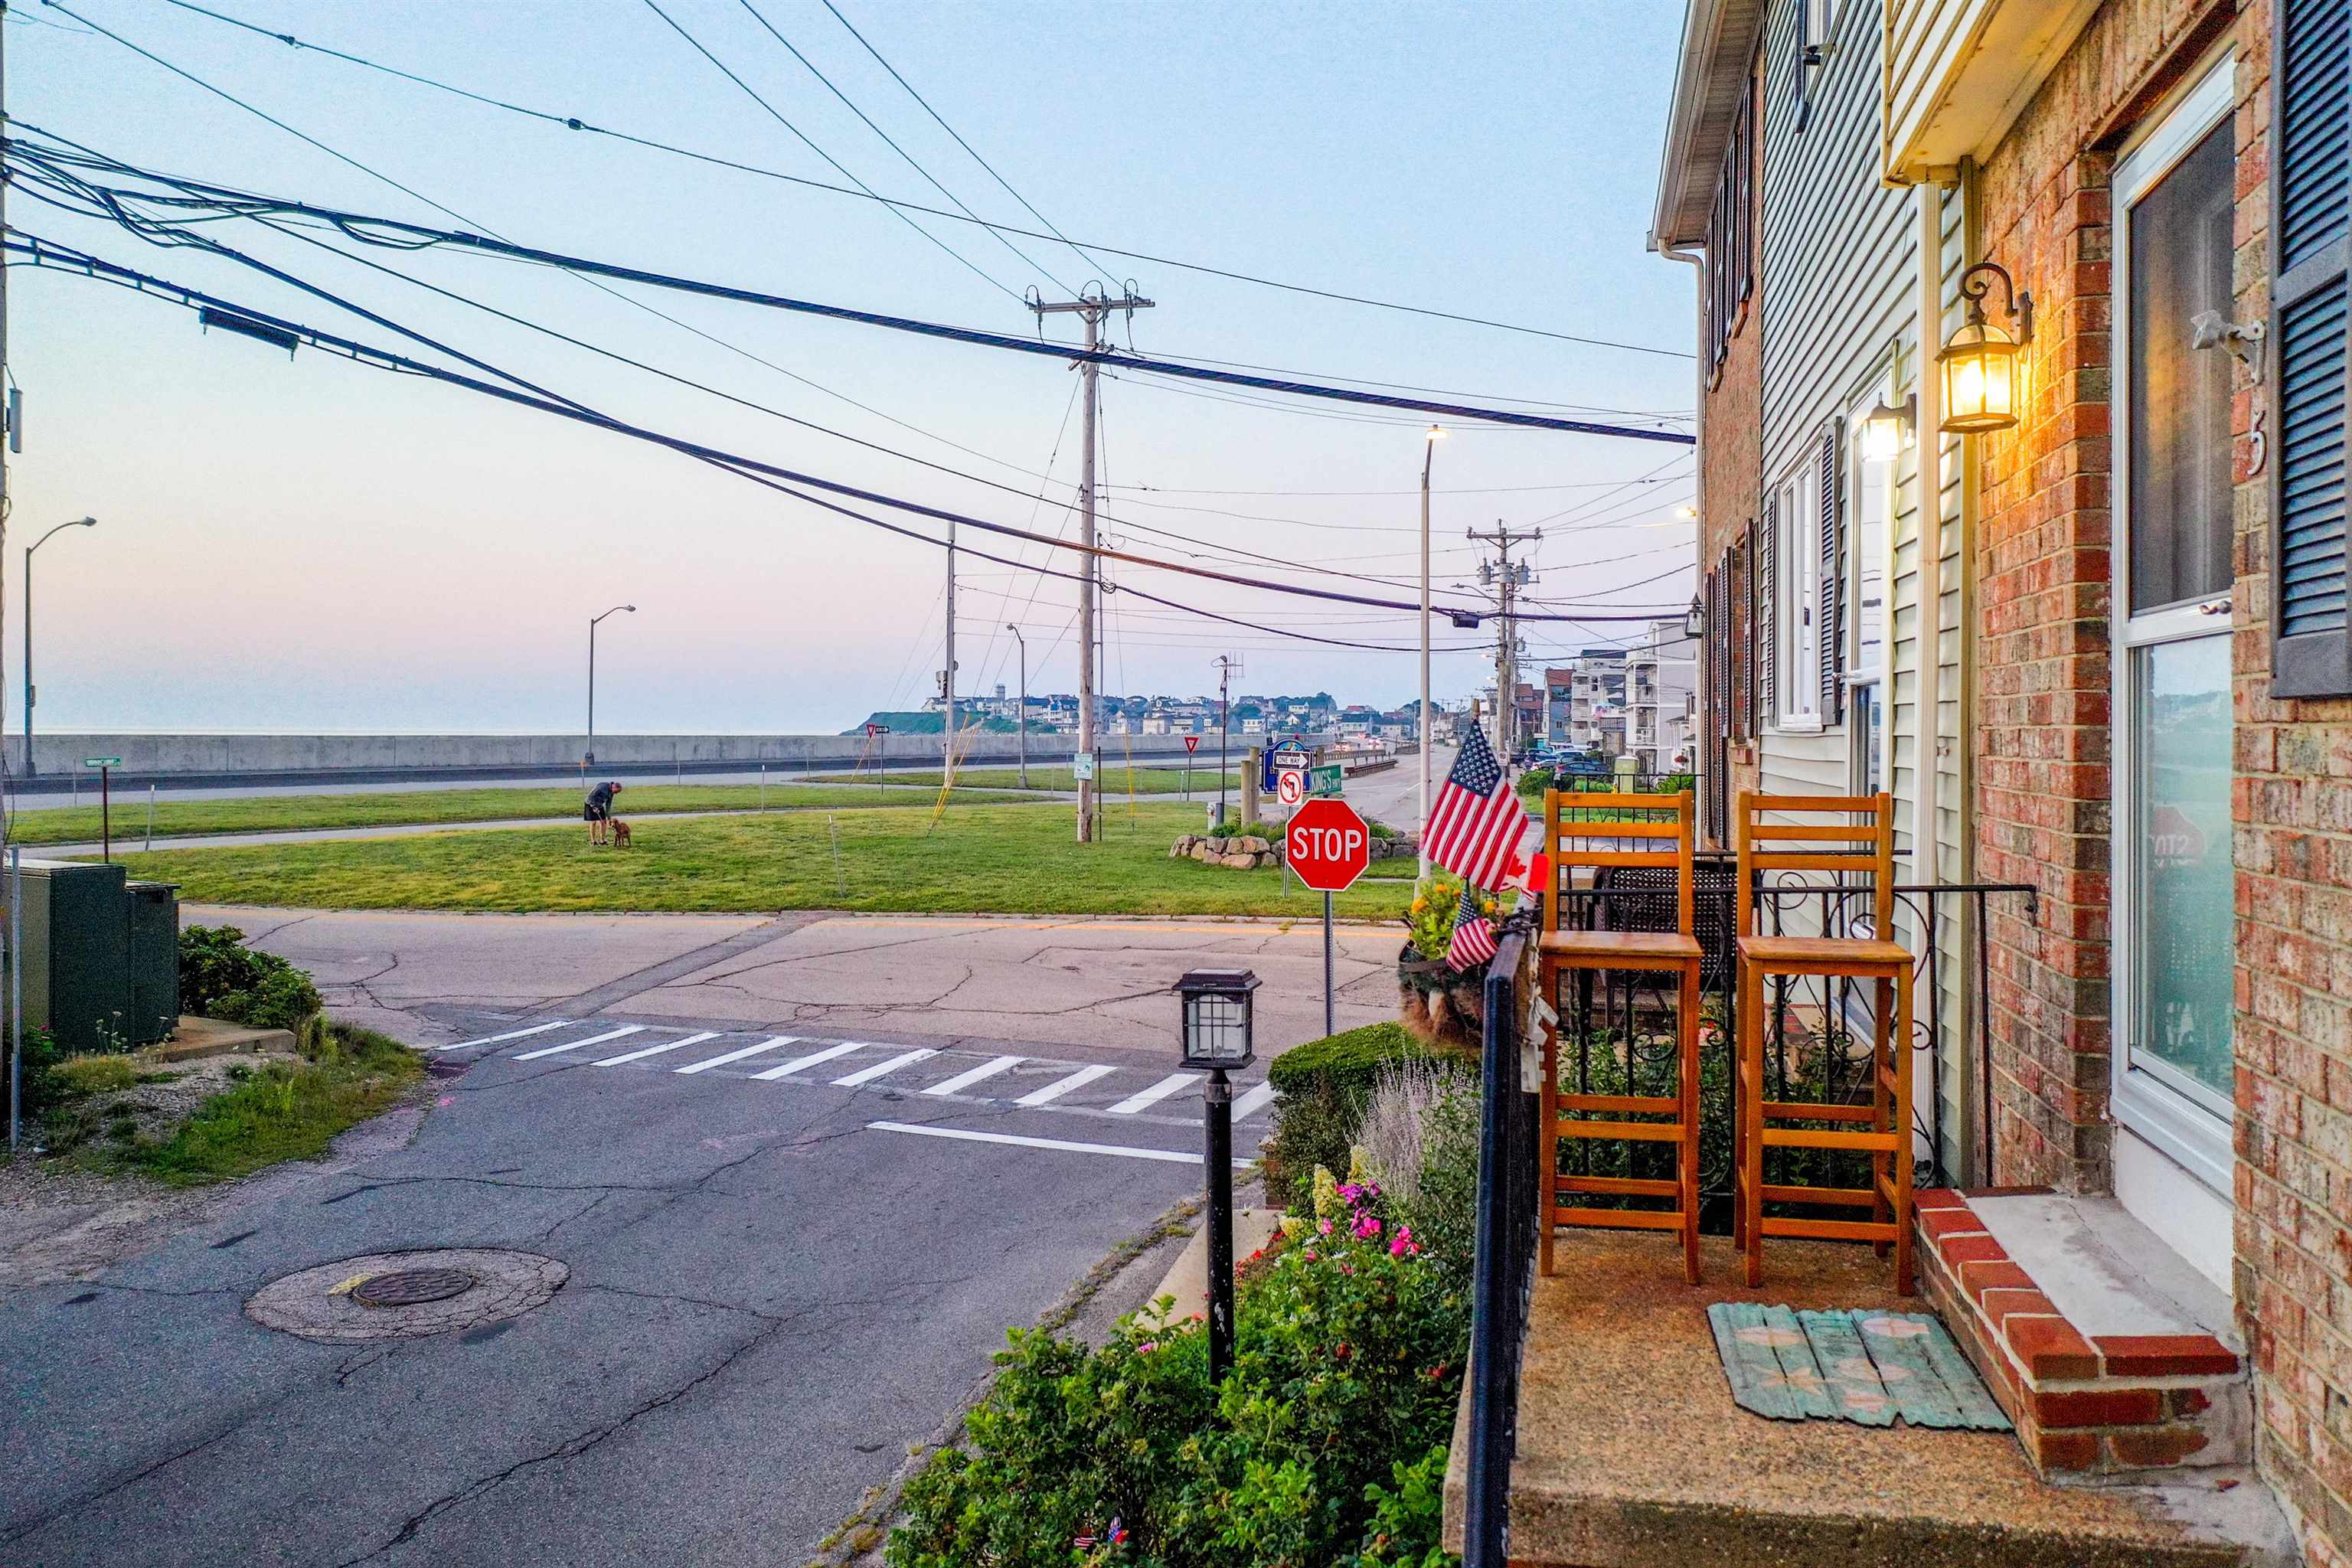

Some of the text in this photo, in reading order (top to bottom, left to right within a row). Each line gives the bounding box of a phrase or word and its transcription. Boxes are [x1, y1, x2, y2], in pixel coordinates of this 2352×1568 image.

[2247, 411, 2266, 475] 5
[1311, 770, 1331, 792] KING'S
[1292, 827, 1362, 861] STOP
